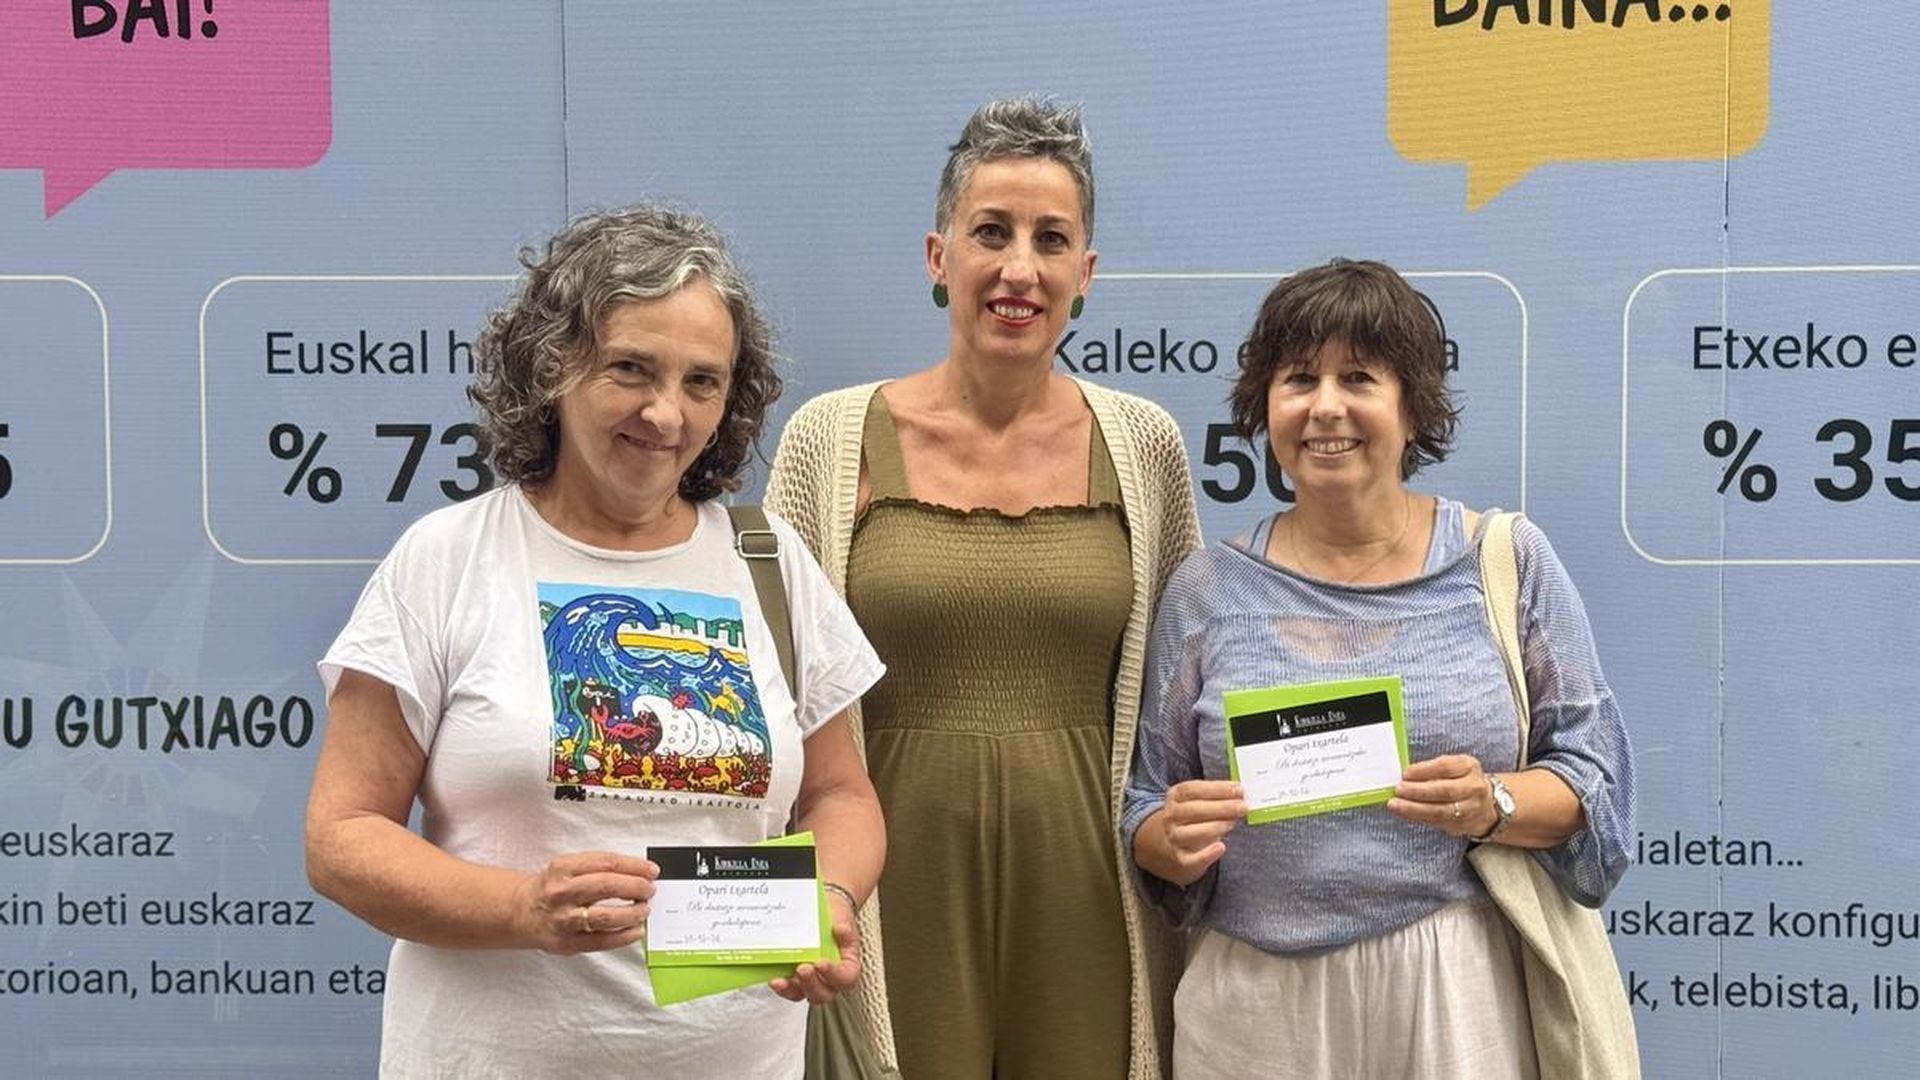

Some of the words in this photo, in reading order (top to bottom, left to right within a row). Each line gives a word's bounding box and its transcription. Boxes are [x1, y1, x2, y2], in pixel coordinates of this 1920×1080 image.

[72, 0, 218, 43] BAI!
[266, 330, 428, 374] Euskal
[1052, 329, 1218, 373] Kaleko
[1693, 322, 1868, 369] Etxeko
[269, 423, 343, 503] %
[375, 423, 495, 502] 73
[1703, 420, 1777, 502] %
[1814, 418, 1920, 502] 35
[56, 695, 314, 753] GUTXIAGO
[0, 823, 175, 857] euskaraz
[1630, 831, 1804, 866] ialetan...
[58, 892, 126, 926] beti
[141, 892, 315, 926] euskaraz
[1769, 902, 1919, 947] konfigu
[152, 960, 314, 994] bankuan
[329, 964, 385, 994] eta
[1671, 972, 1858, 1015] telebista,
[1874, 974, 1920, 1010] lib
